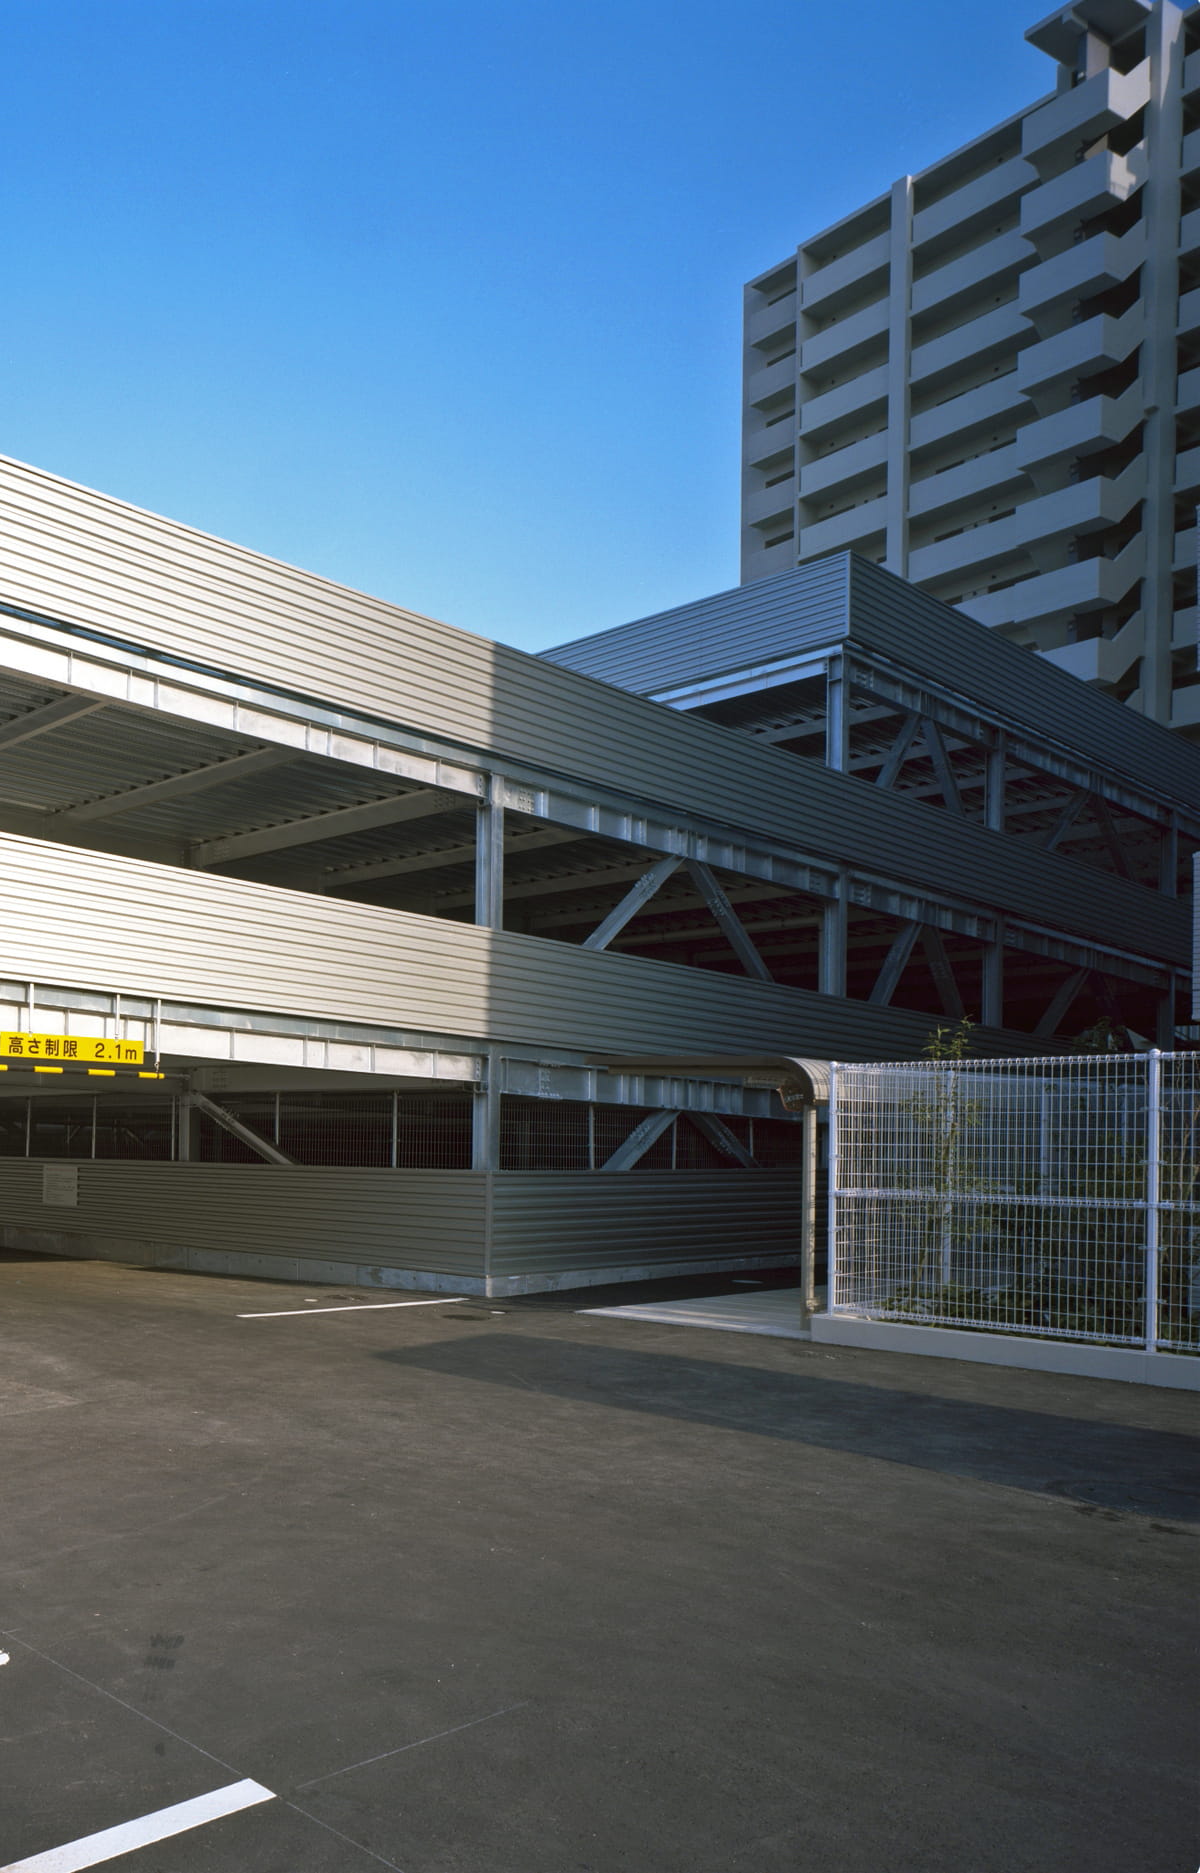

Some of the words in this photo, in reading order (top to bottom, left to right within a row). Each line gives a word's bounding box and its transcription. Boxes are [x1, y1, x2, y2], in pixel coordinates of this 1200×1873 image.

[8, 1036, 78, 1058] 高さ制限
[94, 1043, 137, 1060] 2.1m
